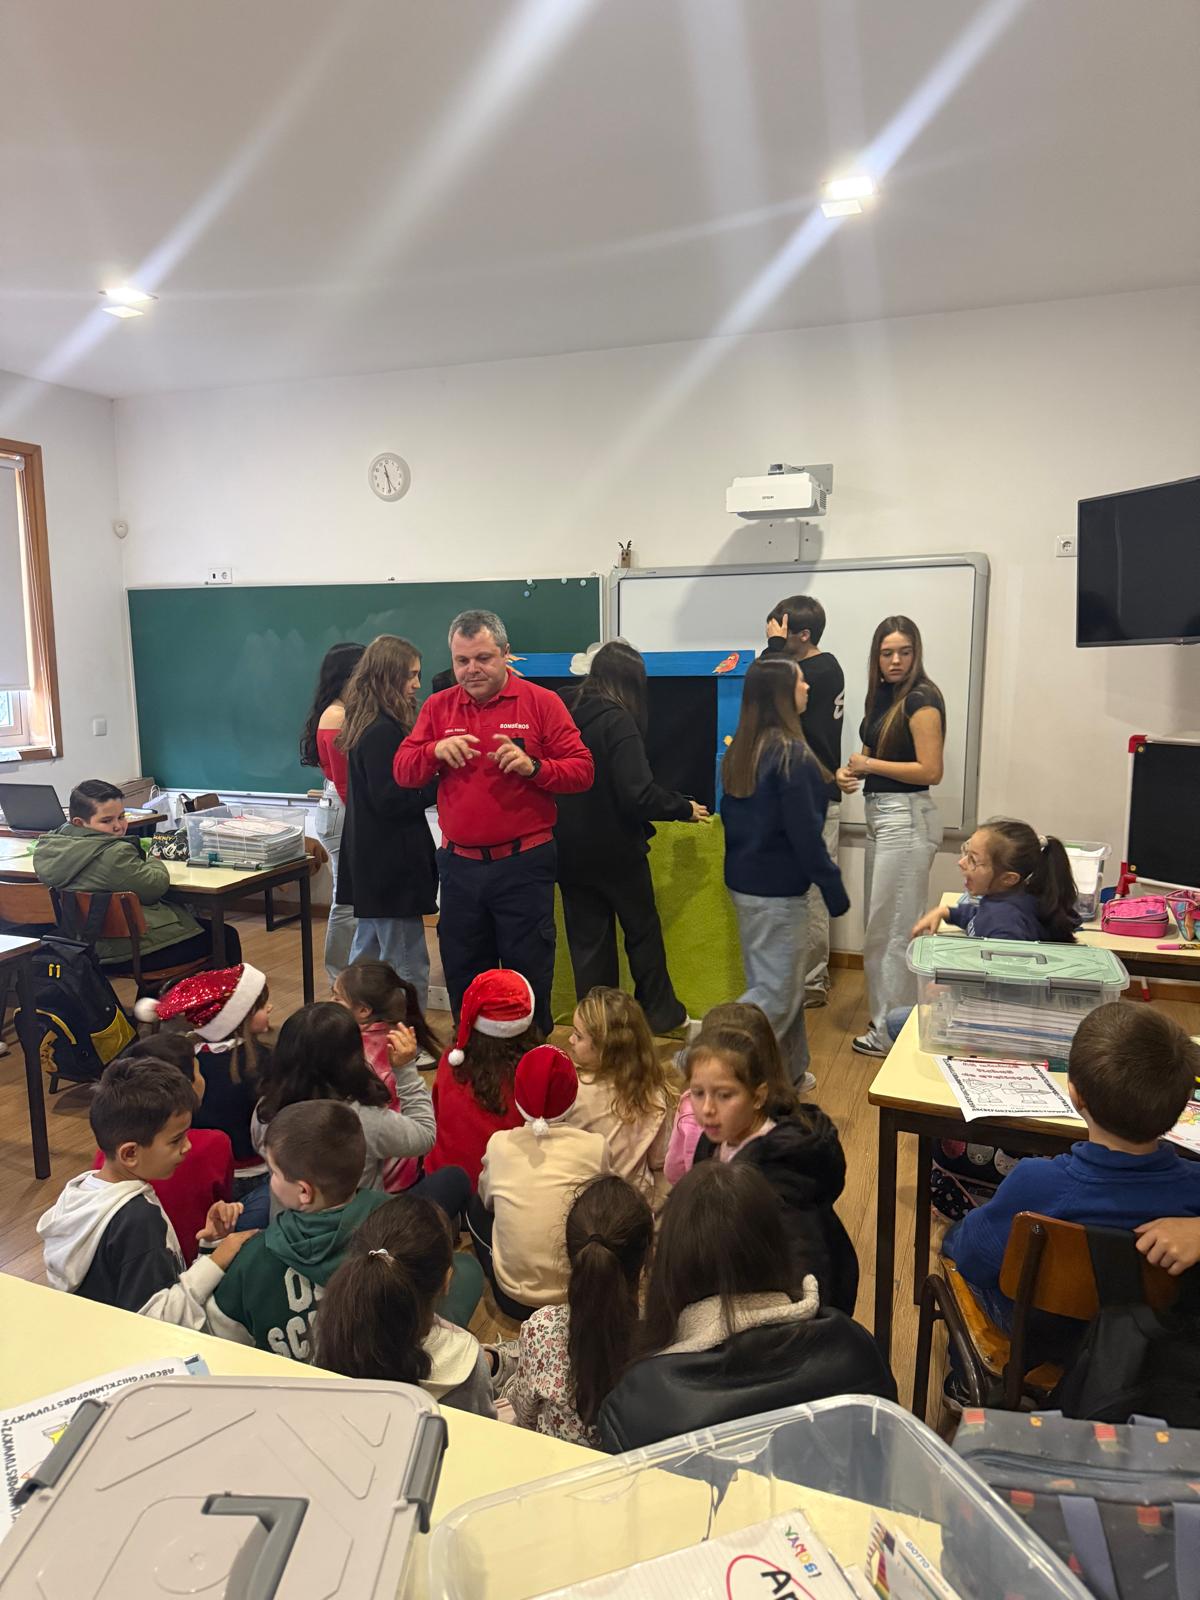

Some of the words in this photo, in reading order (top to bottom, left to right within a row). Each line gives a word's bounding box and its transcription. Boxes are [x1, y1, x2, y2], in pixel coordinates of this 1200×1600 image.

[284, 1266, 326, 1313] O
[267, 1311, 318, 1364] SC
[785, 1525, 822, 1579] VAMOS!
